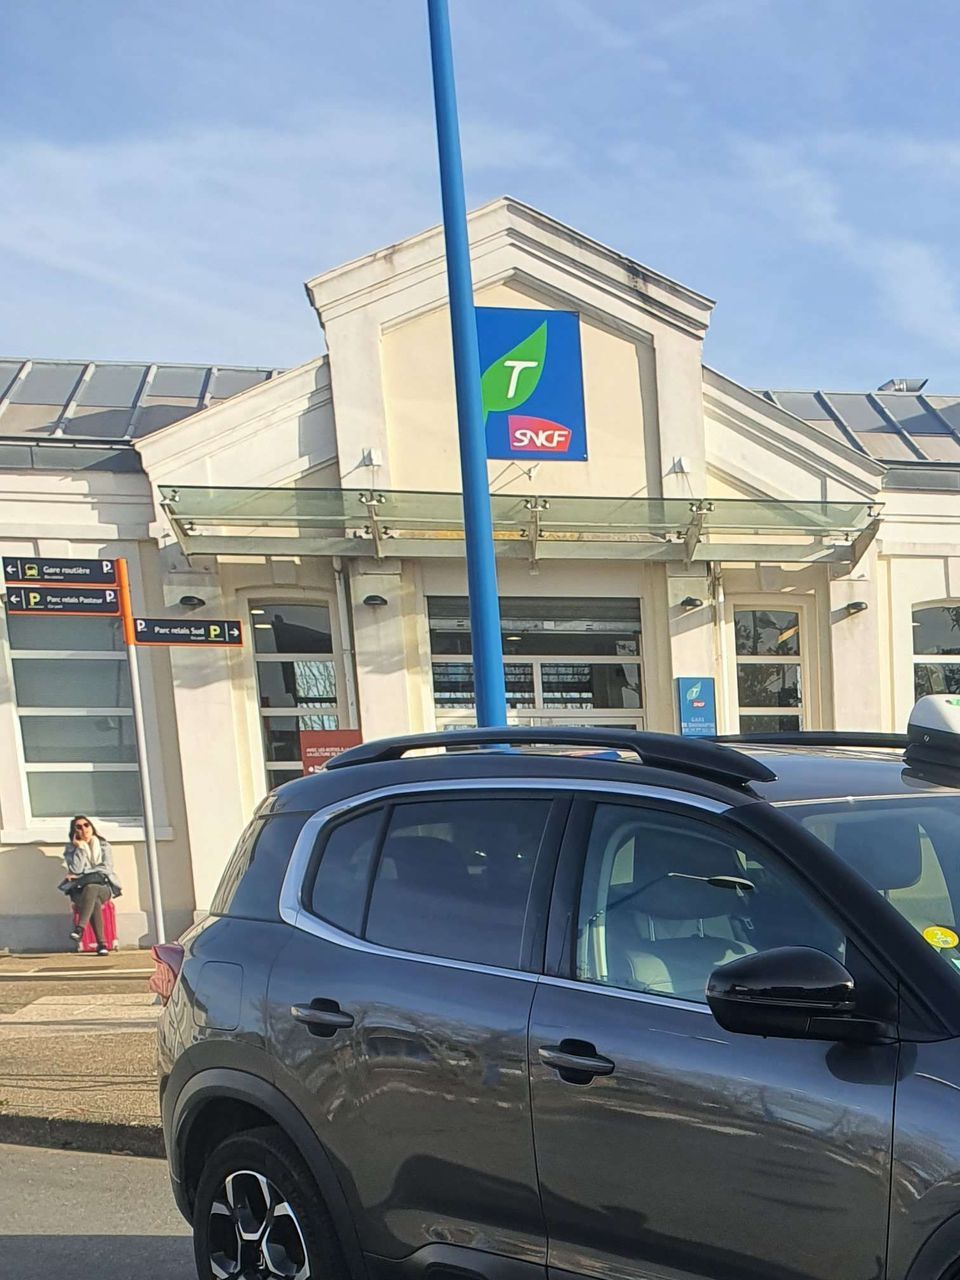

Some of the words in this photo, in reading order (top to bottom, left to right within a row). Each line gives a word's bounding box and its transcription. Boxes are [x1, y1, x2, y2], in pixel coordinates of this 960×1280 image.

[503, 360, 539, 399] T
[512, 429, 569, 448] SNCF
[43, 566, 61, 574] Gare
[62, 566, 91, 575] routière
[79, 596, 103, 604] Pasteur
[154, 626, 170, 634] Parc
[190, 627, 205, 635] Sud
